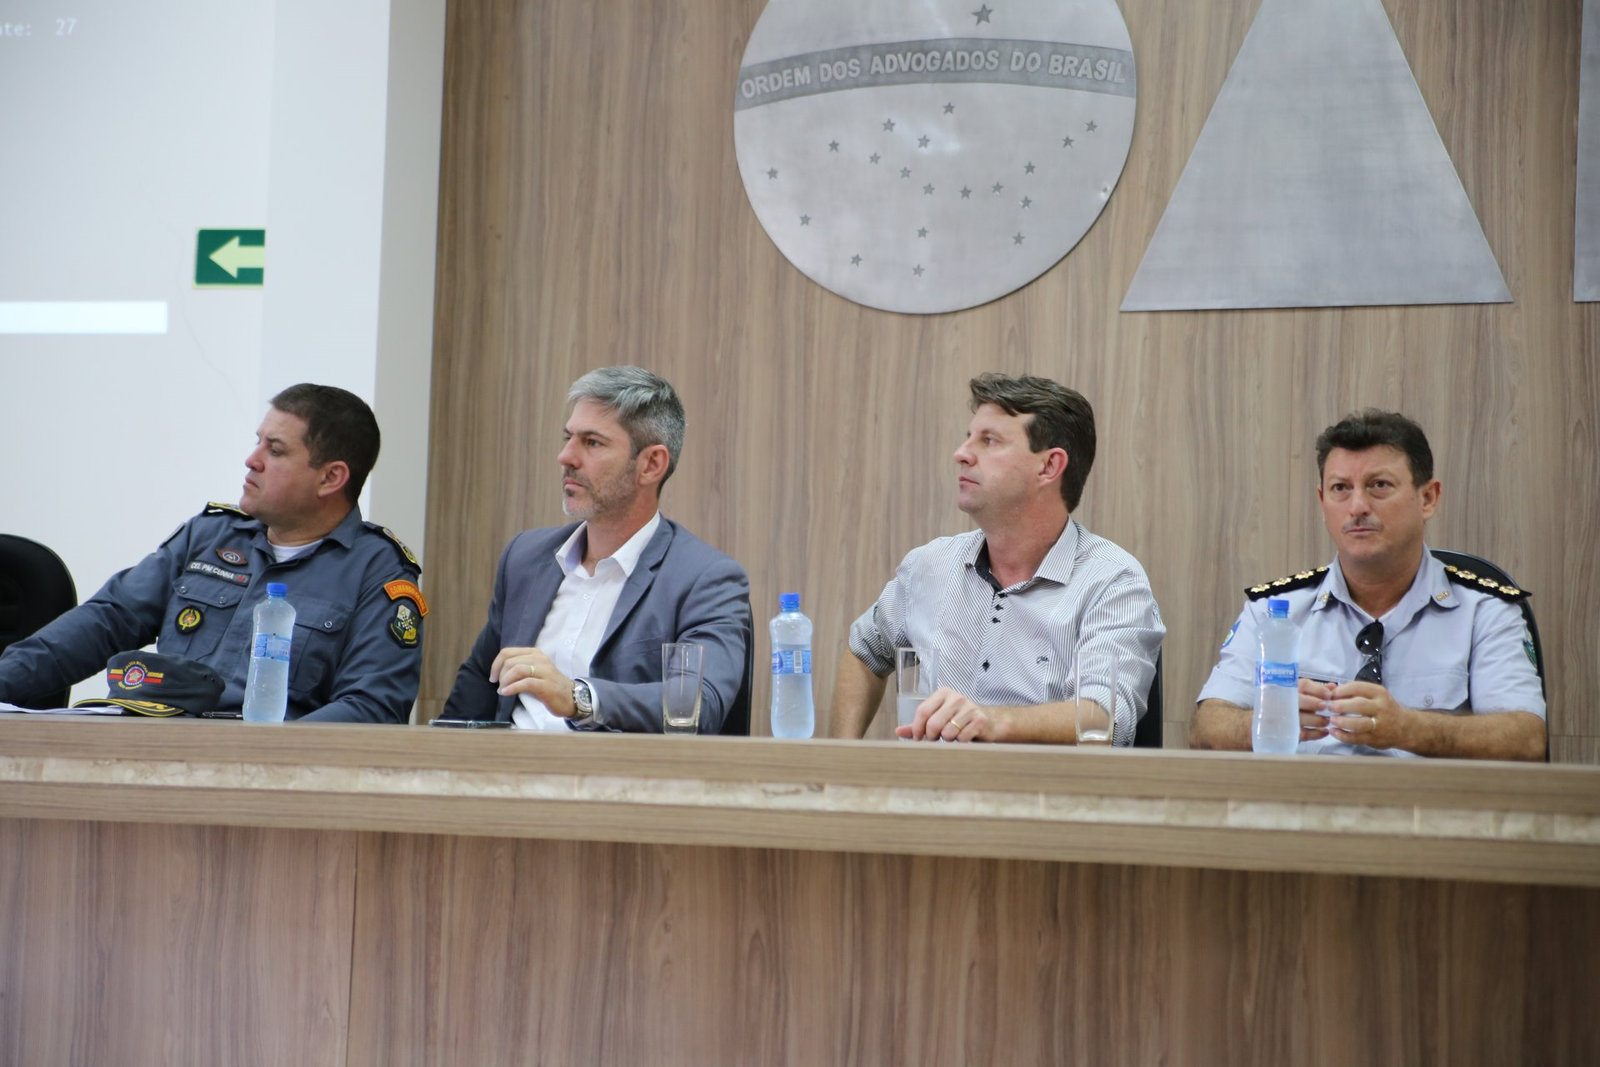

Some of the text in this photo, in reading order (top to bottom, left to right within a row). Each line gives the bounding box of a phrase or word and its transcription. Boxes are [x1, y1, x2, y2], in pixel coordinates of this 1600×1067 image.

[0, 18, 78, 37] te: 27
[741, 49, 1126, 99] ORDEM DOS ADVOGADOS DO BRASIL
[212, 567, 234, 579] CUNHA
